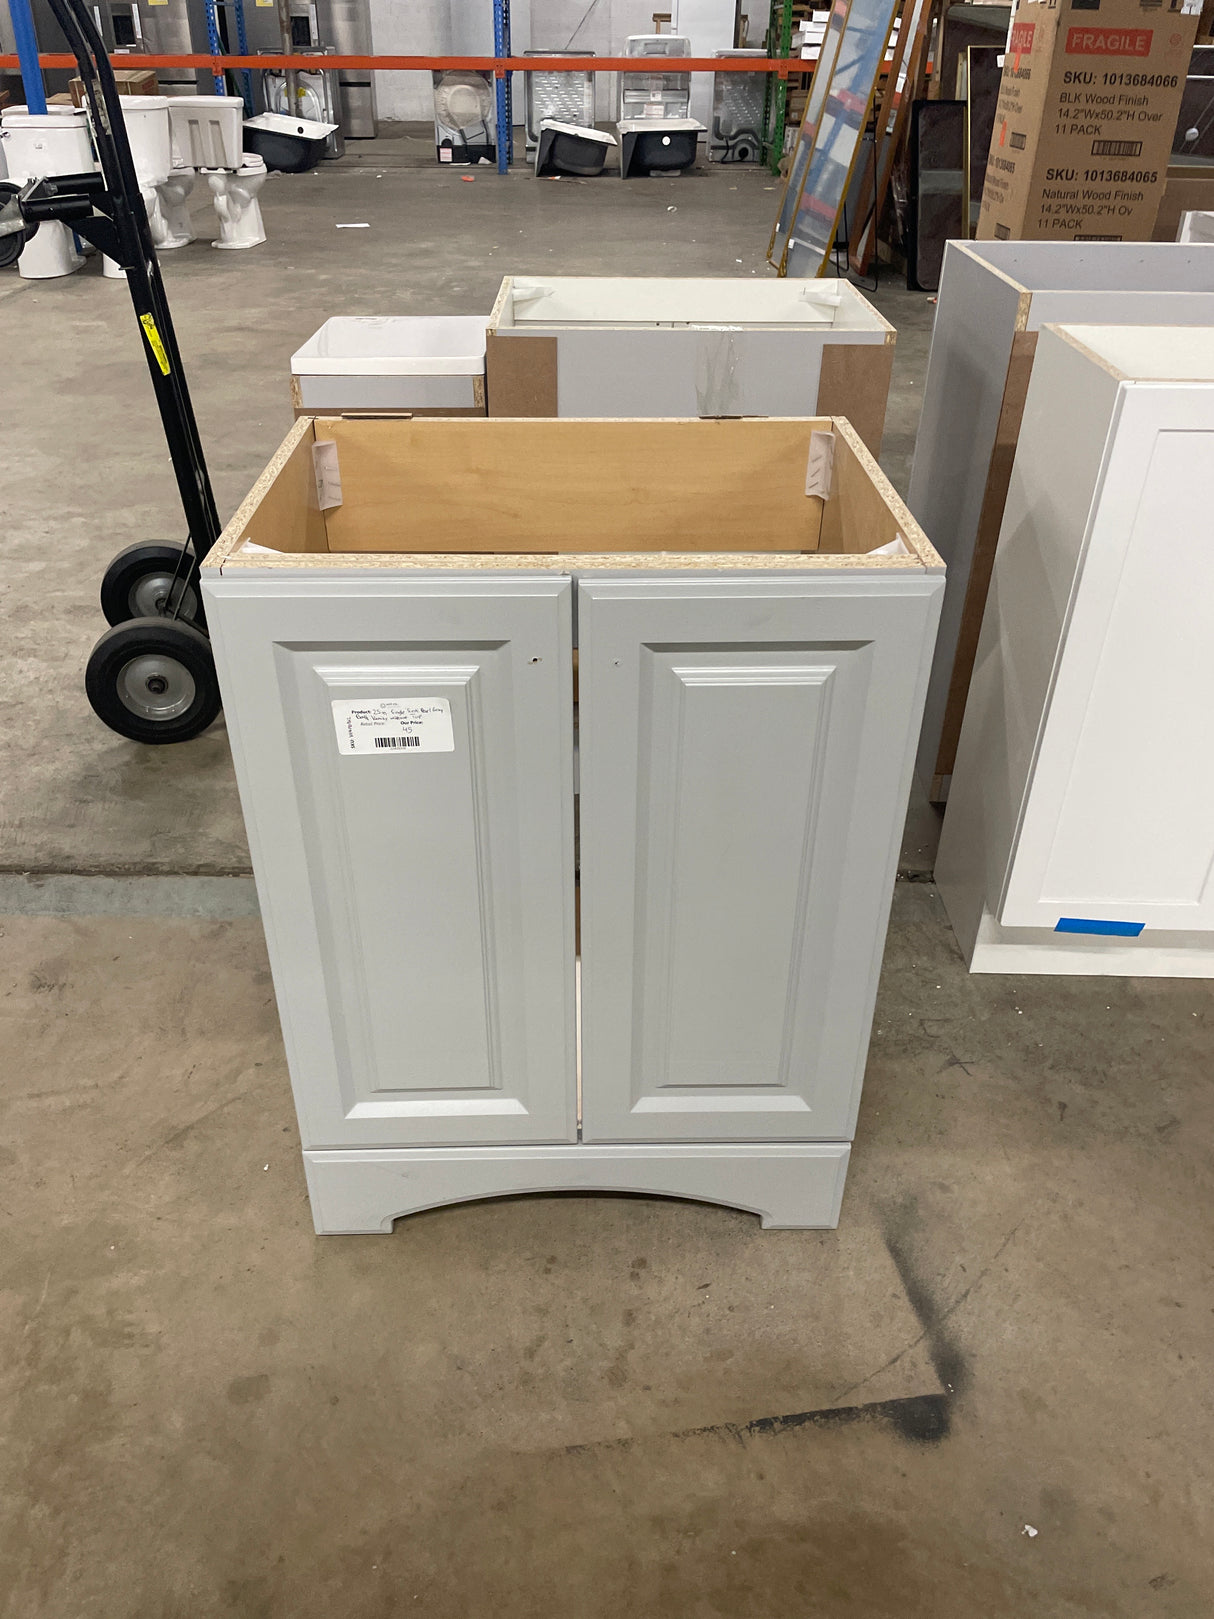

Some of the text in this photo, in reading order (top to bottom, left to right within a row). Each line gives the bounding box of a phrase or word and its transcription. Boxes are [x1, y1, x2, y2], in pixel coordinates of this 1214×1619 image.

[1072, 32, 1147, 51] FRAGILE
[1063, 71, 1178, 88] SKU: 1013684066
[1060, 92, 1149, 106] BLK Wood Finish
[1138, 110, 1163, 122] Over
[1055, 124, 1103, 136] 11 PACK
[1046, 168, 1158, 183] SKU: 1013684065
[1042, 188, 1144, 201] Natural Wood Finish
[1118, 205, 1133, 216] Ov
[1038, 218, 1083, 229] 11 PACK
